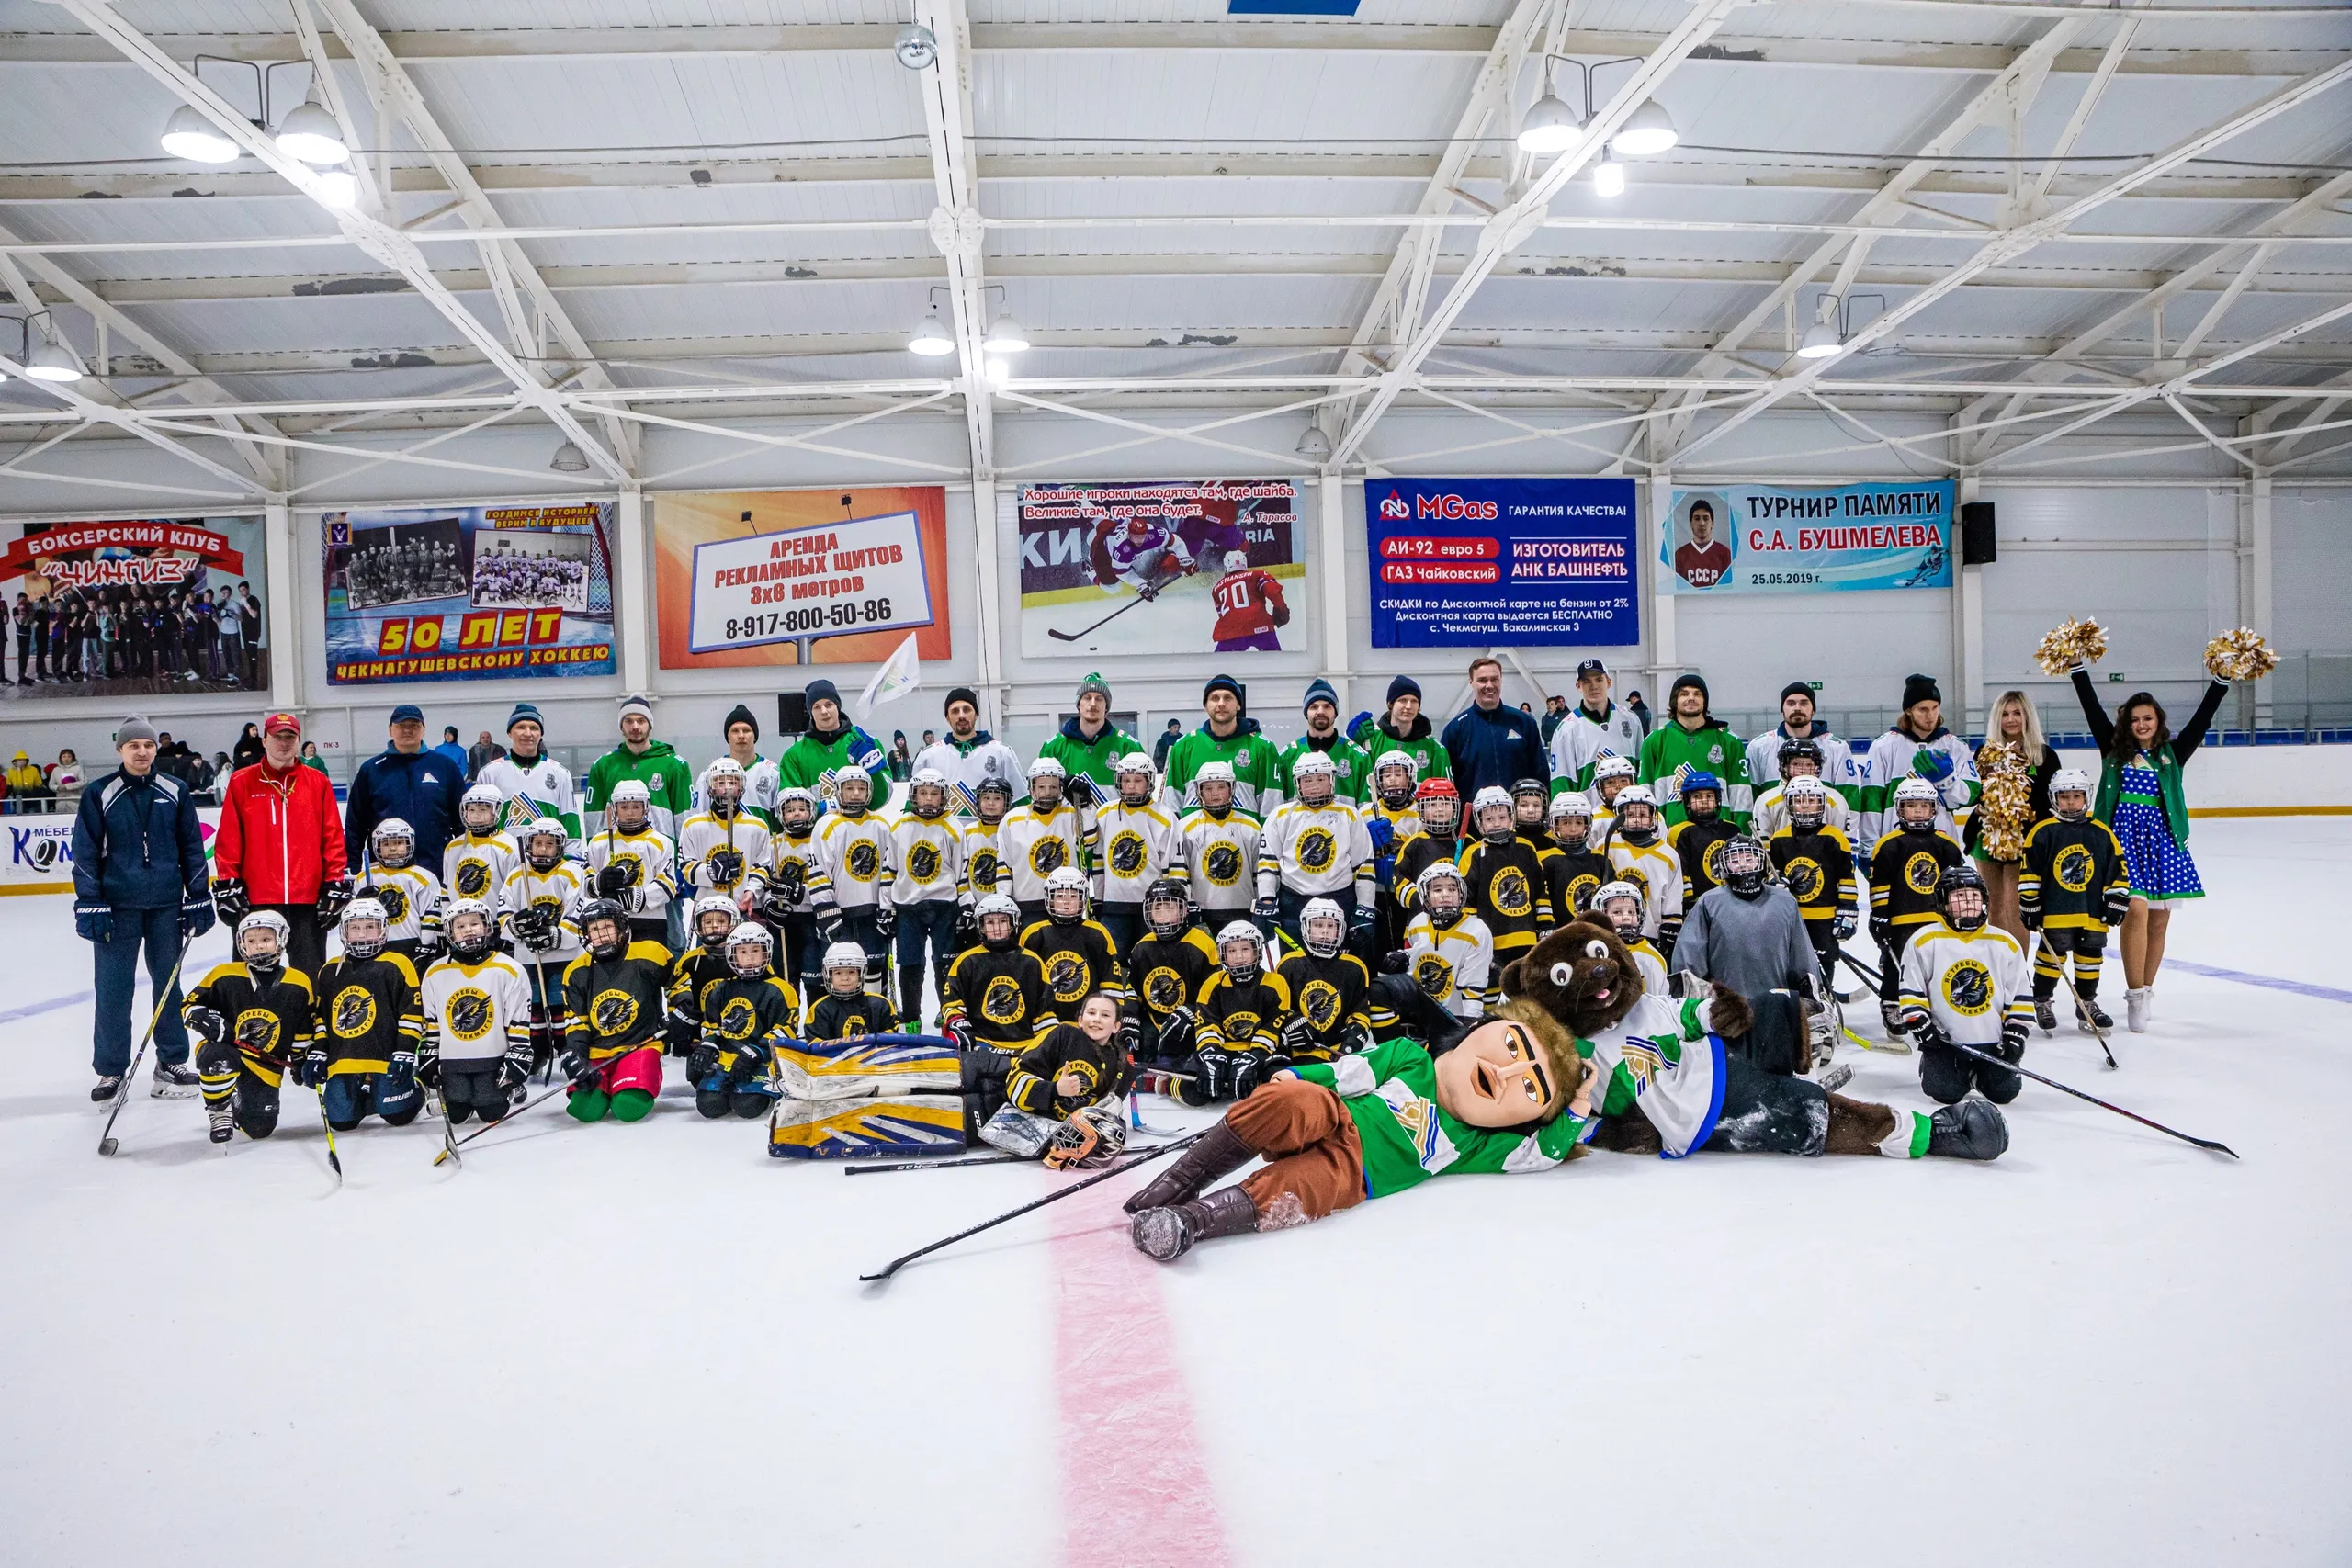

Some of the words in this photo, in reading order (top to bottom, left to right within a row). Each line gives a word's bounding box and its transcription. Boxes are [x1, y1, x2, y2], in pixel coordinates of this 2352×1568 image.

[1024, 488, 1083, 502] Хорошие
[1086, 487, 1130, 501] игроки
[1133, 486, 1198, 500] находятся
[1200, 487, 1227, 500] там,
[1229, 486, 1251, 500] где
[1253, 484, 1297, 498] шайба.
[486, 509, 540, 519] ГОРДИМСЯ
[543, 507, 599, 517] ИСТОРИЕЙ!
[1024, 506, 1081, 519] Великие
[1083, 506, 1109, 519] там,
[1111, 506, 1132, 519] где
[1135, 505, 1159, 518] она
[1161, 503, 1203, 517] будет.
[1417, 494, 1498, 519] MGas
[1509, 506, 1563, 516] ГАРАНТИЯ
[1567, 506, 1626, 516] КАЧЕСТВА!
[1747, 495, 1838, 519] ТУРНИР
[1844, 491, 1941, 516] ПАМЯТИ
[495, 518, 527, 528] ВЕРИМ
[530, 519, 537, 527] В
[539, 516, 591, 527] БУДУЩЕЕ!
[1243, 512, 1254, 523] А.
[1256, 511, 1298, 523] Тарасов
[28, 526, 164, 554] БОКСЕРСКИЙ
[170, 530, 220, 552] КЛУБ
[770, 532, 838, 559] АРЕНДА
[1749, 529, 1792, 552] С.А.
[1798, 524, 1942, 551] БУШМЕЛЕВА
[1387, 541, 1433, 555] АИ-92
[1441, 546, 1472, 557] евро
[1477, 544, 1484, 555] 5
[1513, 544, 1625, 557] ИЗГОТОВИТЕЛЬ
[715, 554, 826, 588] РЕКЛАМНЫХ
[833, 544, 903, 571] ЩИТОВ
[1387, 566, 1413, 579] ГАЗ
[1417, 565, 1496, 580] Чайковский
[1511, 564, 1544, 577] АНК
[1547, 563, 1628, 576] БАШНЕФТЬ
[1687, 568, 1719, 584] СССР
[1751, 573, 1813, 585] 25.05.2019
[1815, 575, 1823, 584] г.
[792, 576, 864, 599] метров
[1218, 581, 1250, 617] 20
[1380, 599, 1422, 609] СКИДКИ
[1425, 601, 1438, 610] по
[1442, 598, 1506, 609] Дисконтной
[1509, 600, 1541, 610] карте
[1544, 600, 1558, 609] на
[1560, 598, 1596, 608] бензин
[1599, 600, 1611, 608] от
[1613, 598, 1628, 608] 2%
[726, 598, 892, 640] 8-917-800-50-86
[1396, 611, 1460, 621] Дисконтная
[1463, 613, 1495, 622] карта
[1498, 612, 1549, 621] выдается
[1552, 610, 1613, 620] БЕСПЛАТНО
[380, 621, 441, 651] 50
[461, 613, 560, 645] ЛЕТ
[1443, 623, 1500, 634] Чекмагуш,
[1503, 623, 1571, 632] Бакалинская
[1573, 623, 1579, 632] 3
[337, 652, 524, 679] ЧЕКМАГУШЕВСКОМУ
[529, 645, 609, 666] ХОККЕЮ
[1944, 960, 1978, 983] ЯСТРЕБЫ
[447, 989, 478, 1010] ЯСТРЕБЫ
[458, 1011, 493, 1039] ЧЕКМАГУШ
